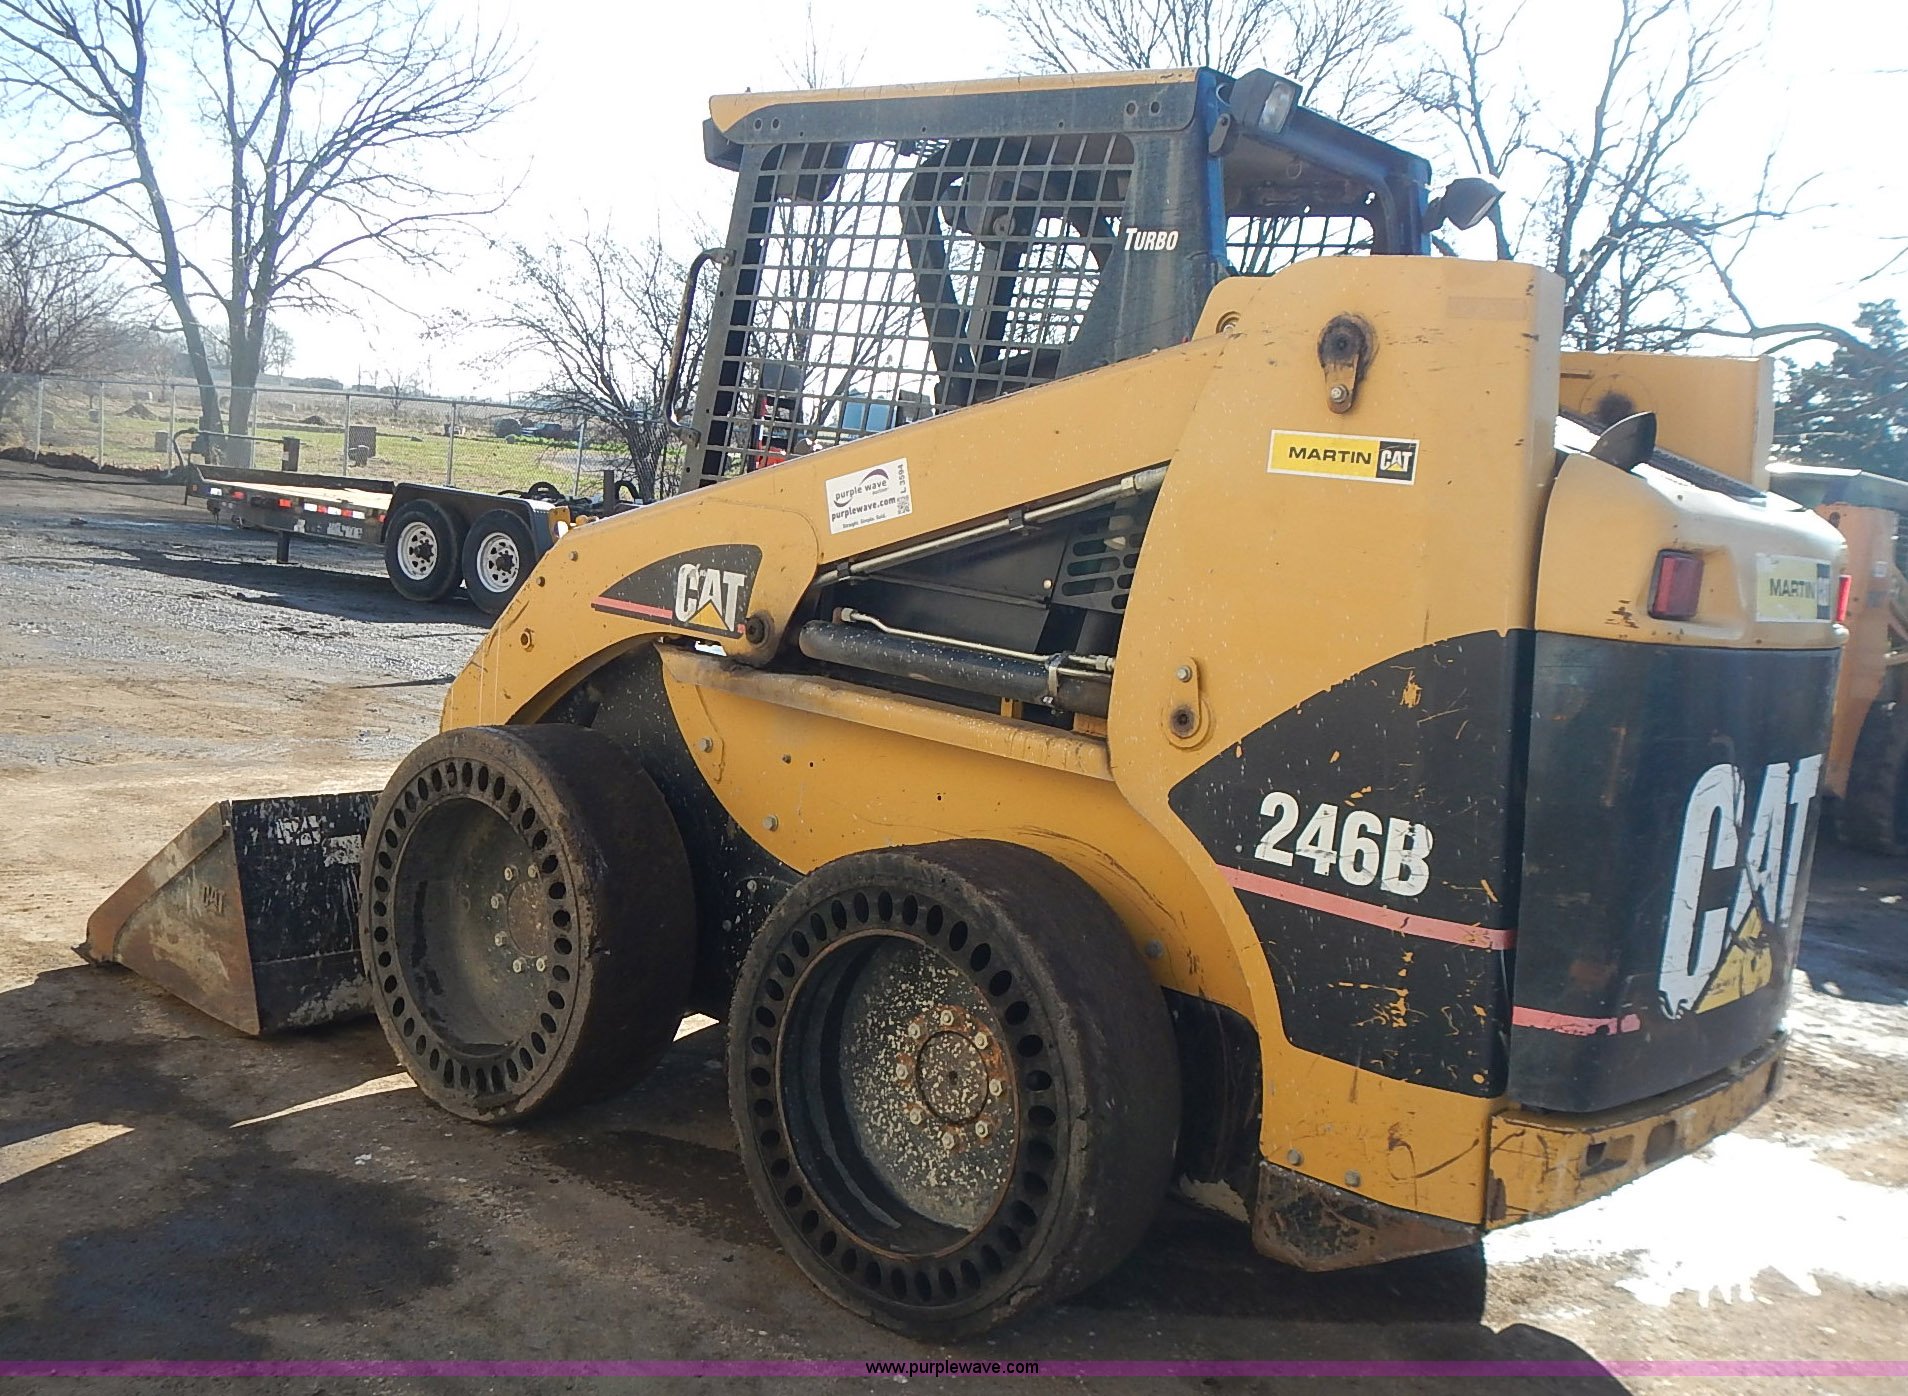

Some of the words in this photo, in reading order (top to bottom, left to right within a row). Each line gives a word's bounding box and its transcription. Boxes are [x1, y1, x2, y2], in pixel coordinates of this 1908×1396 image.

[1124, 227, 1179, 251] TURBO
[1288, 446, 1372, 465] MARTIN
[1379, 449, 1412, 473] CAT
[897, 464, 906, 486] 3594
[835, 486, 862, 501] purple
[864, 479, 887, 492] wave
[831, 496, 896, 522] purplewave.com
[674, 563, 748, 632] CAT
[1769, 578, 1816, 599] MARTIN
[1254, 791, 1434, 897] 246B
[1658, 753, 1824, 1020] CAT
